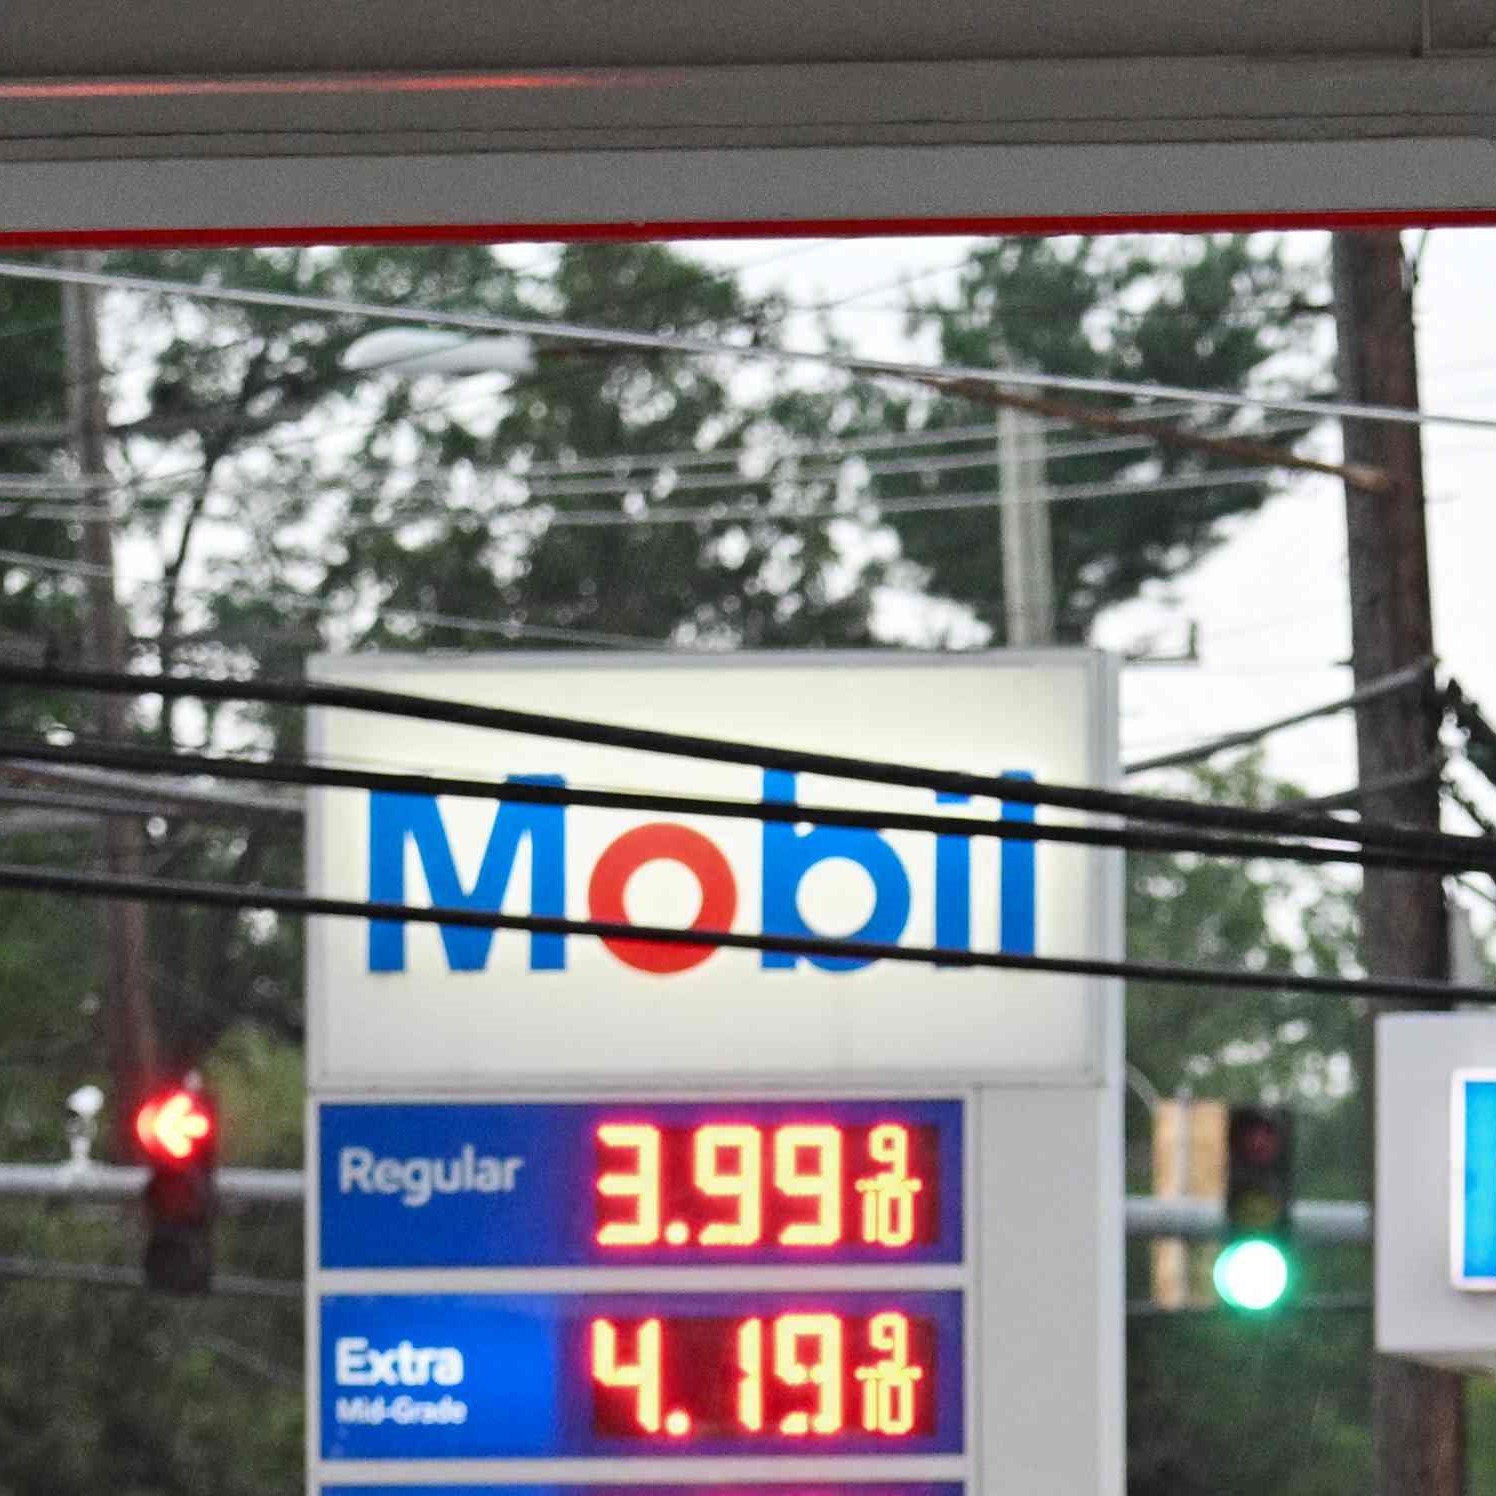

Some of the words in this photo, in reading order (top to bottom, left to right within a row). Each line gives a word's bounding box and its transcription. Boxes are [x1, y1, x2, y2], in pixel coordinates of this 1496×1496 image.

[367, 770, 1039, 975] Mobil
[339, 1146, 523, 1209] Regular
[596, 1124, 843, 1247] 3.99
[335, 1336, 464, 1386] Extra
[591, 1313, 843, 1438] 4.19
[335, 1394, 468, 1425] Mid-Grade
